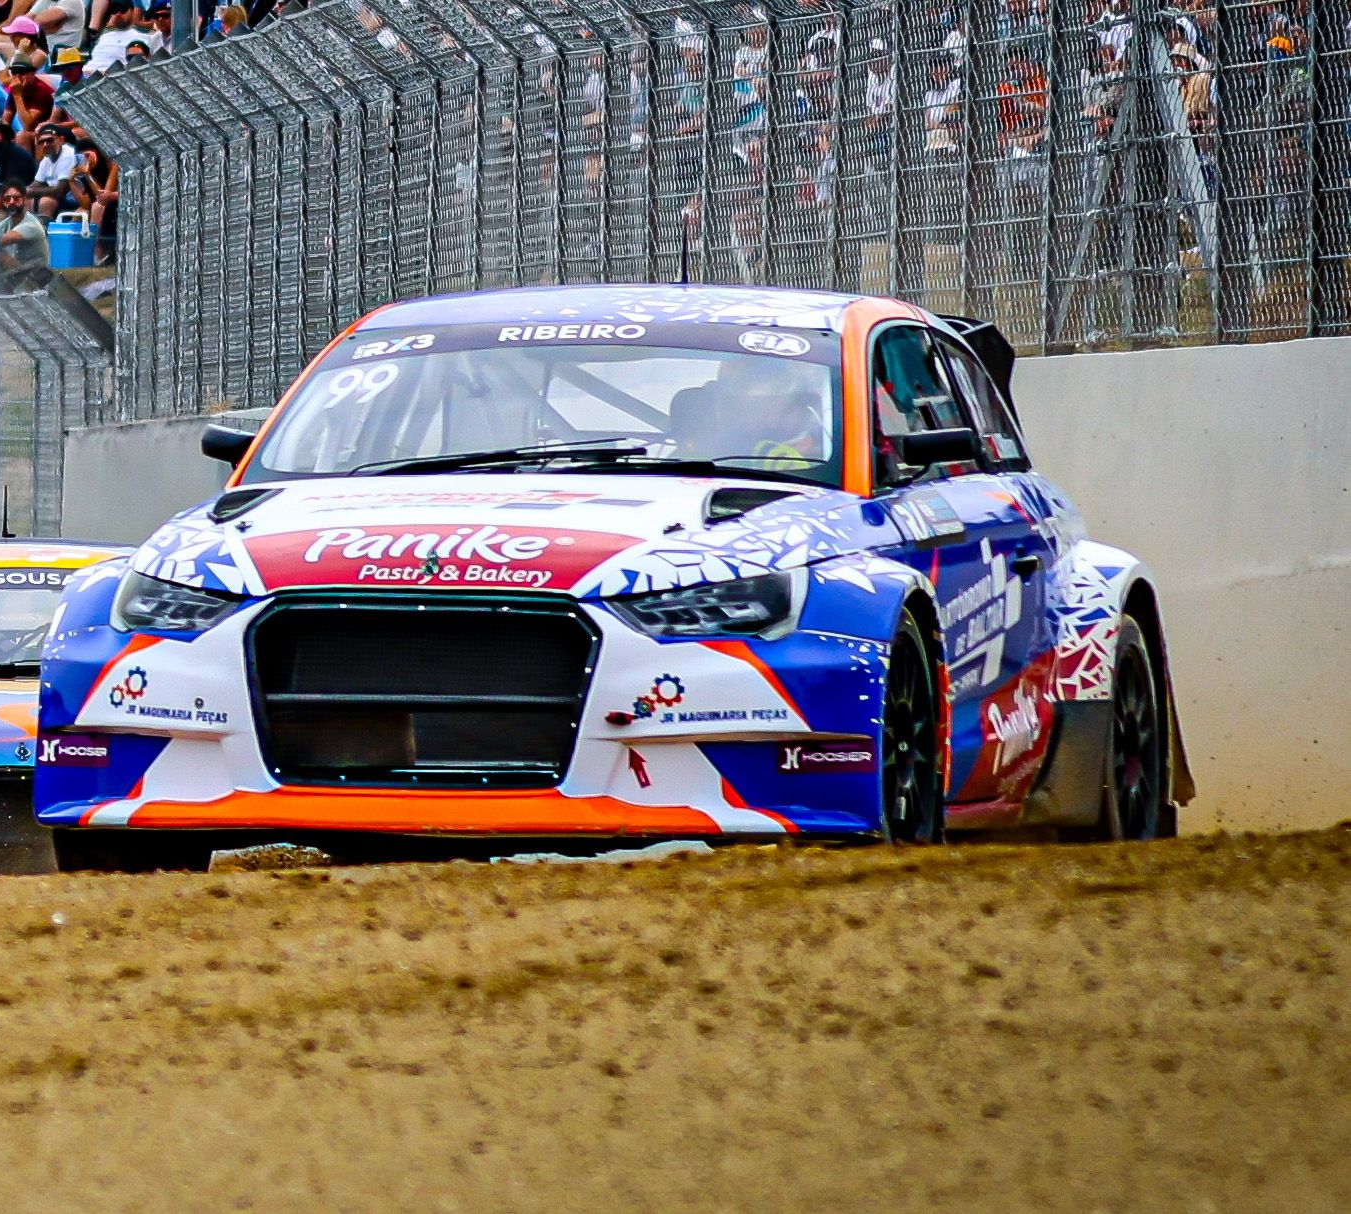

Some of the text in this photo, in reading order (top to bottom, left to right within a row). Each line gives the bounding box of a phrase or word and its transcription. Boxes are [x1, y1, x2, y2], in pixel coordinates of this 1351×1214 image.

[497, 324, 647, 342] RIBEIRO
[742, 332, 807, 355] FIA
[323, 364, 399, 410] 99
[303, 525, 550, 564] Panike
[358, 565, 553, 588] Pastry & Bakery
[196, 710, 228, 725] PEÇAS
[660, 712, 674, 723] JR
[751, 709, 788, 723] PEÇAS
